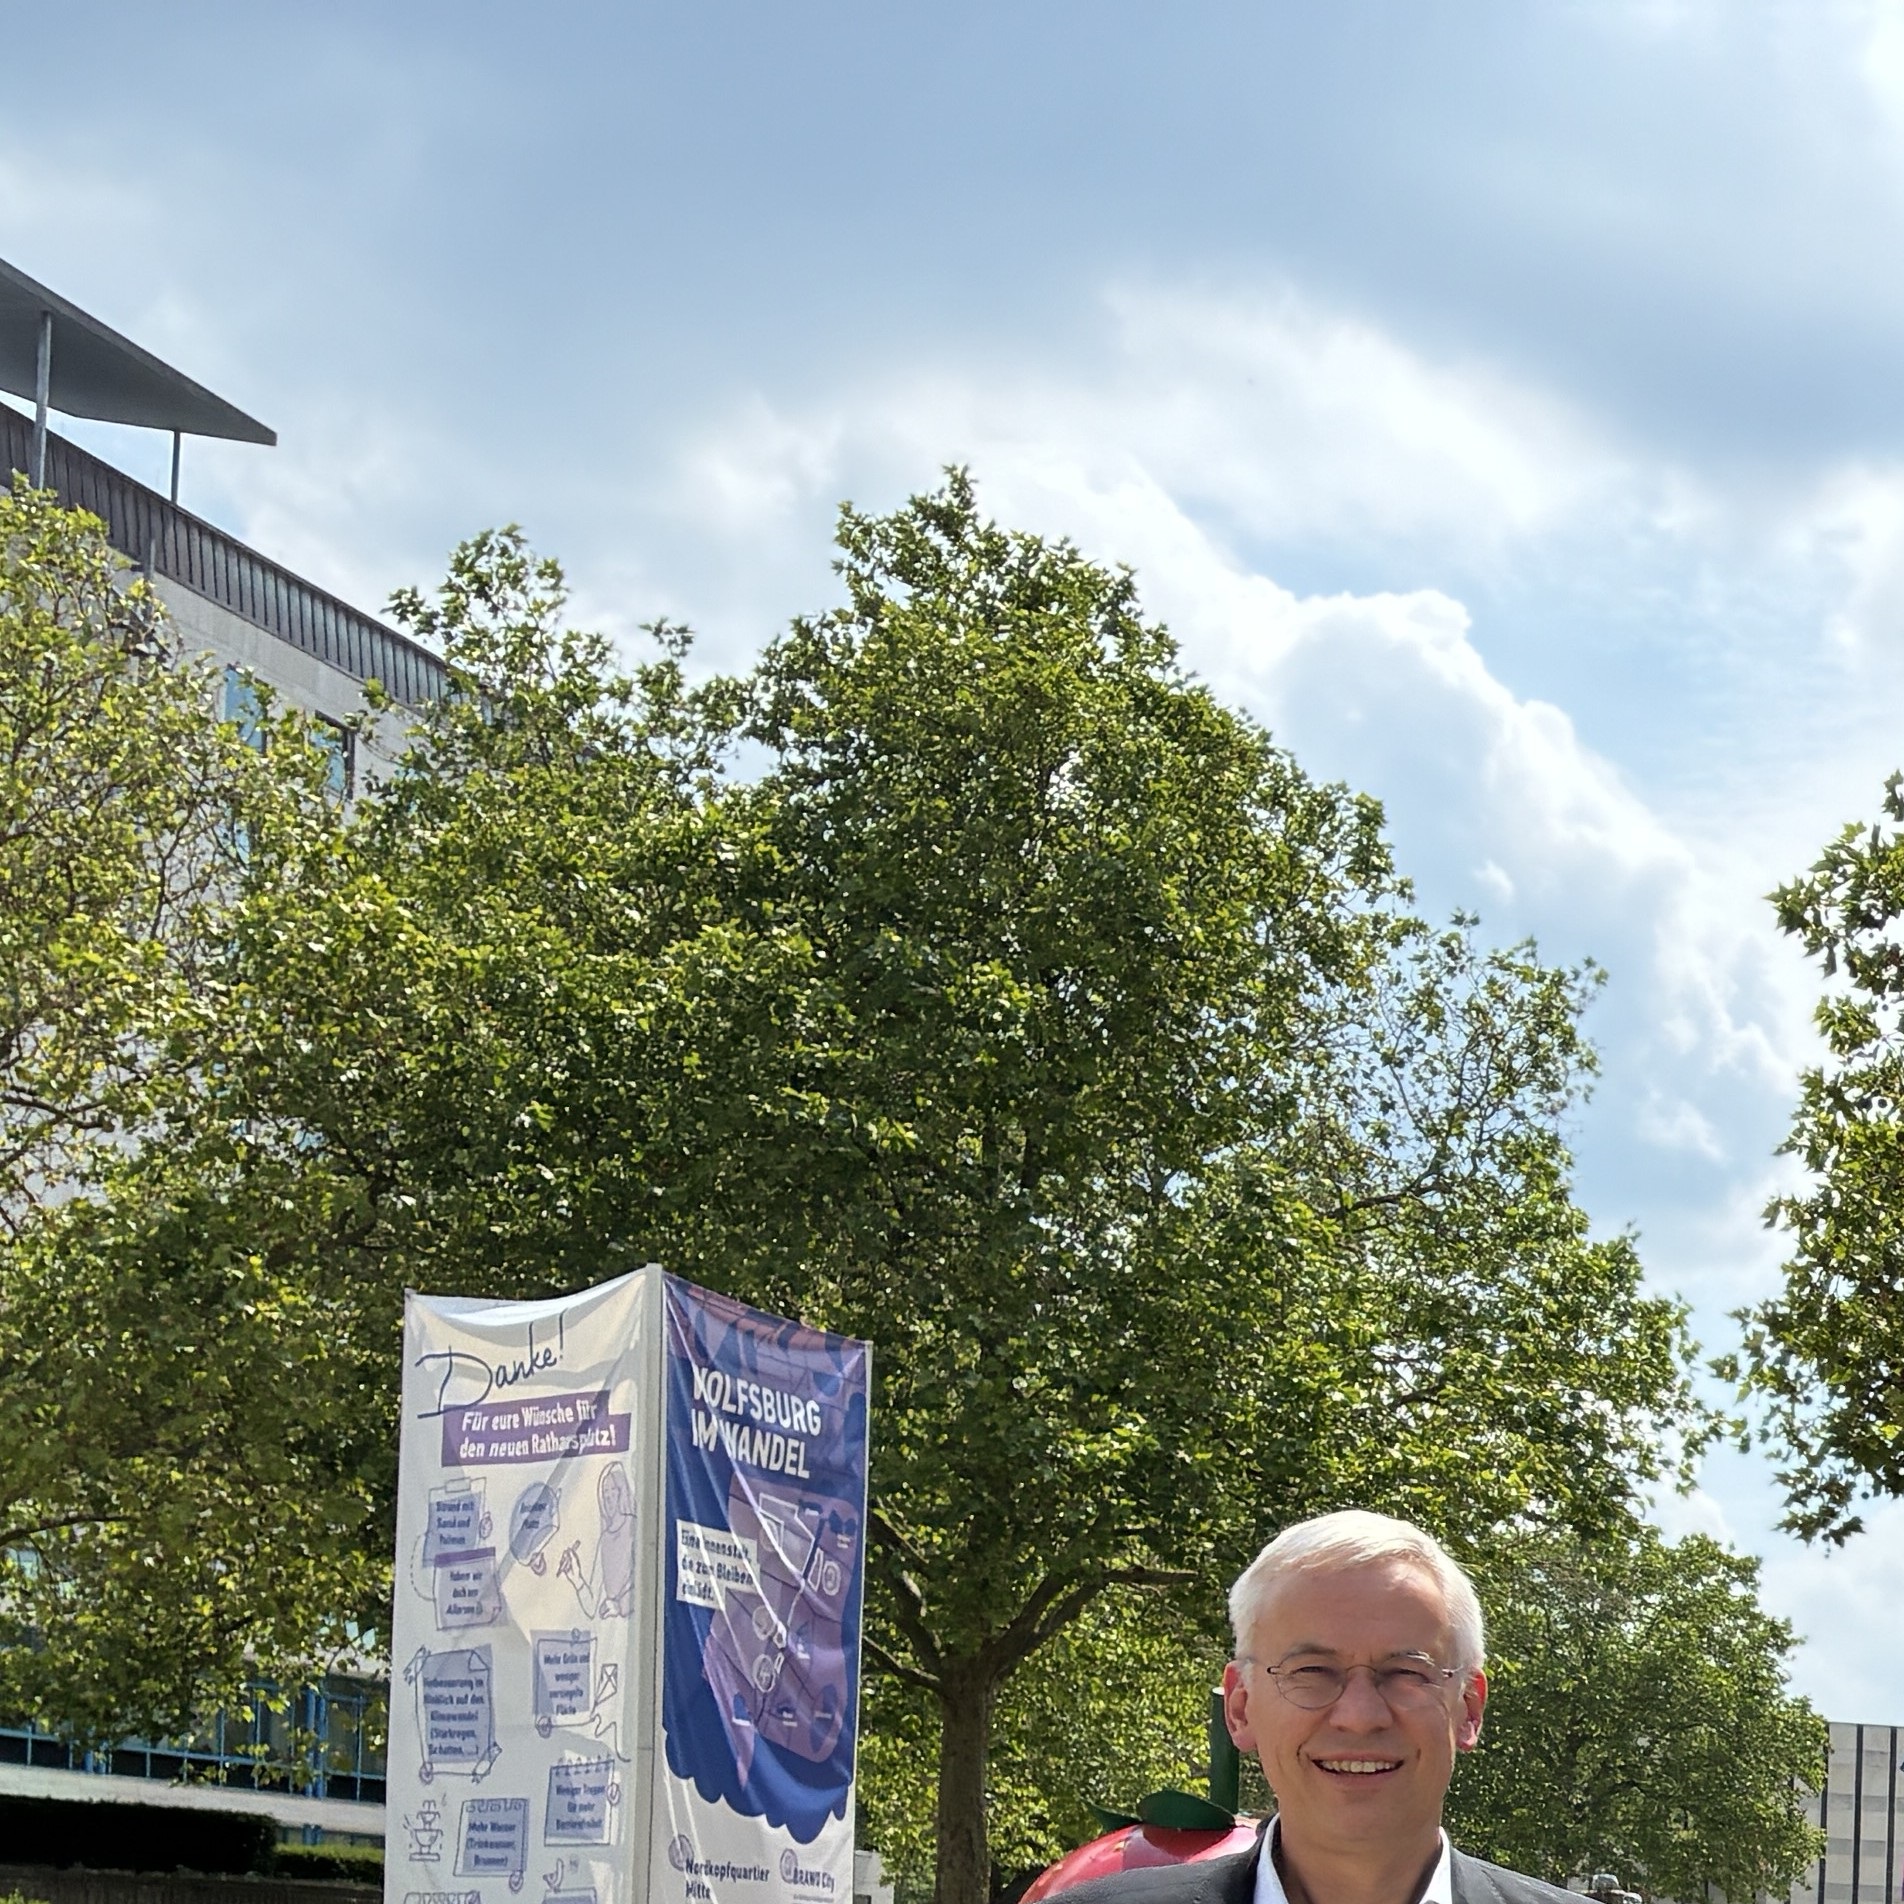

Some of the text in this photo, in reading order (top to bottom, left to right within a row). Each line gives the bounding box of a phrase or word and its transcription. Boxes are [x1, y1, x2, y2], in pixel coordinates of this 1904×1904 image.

[415, 1308, 569, 1419] Danke!
[461, 1411, 488, 1432] Für
[491, 1415, 520, 1431] eure
[521, 1401, 575, 1427] Wünsche
[459, 1438, 485, 1459] den
[489, 1438, 530, 1458] neuen
[691, 1408, 811, 1479] IM WANDEL
